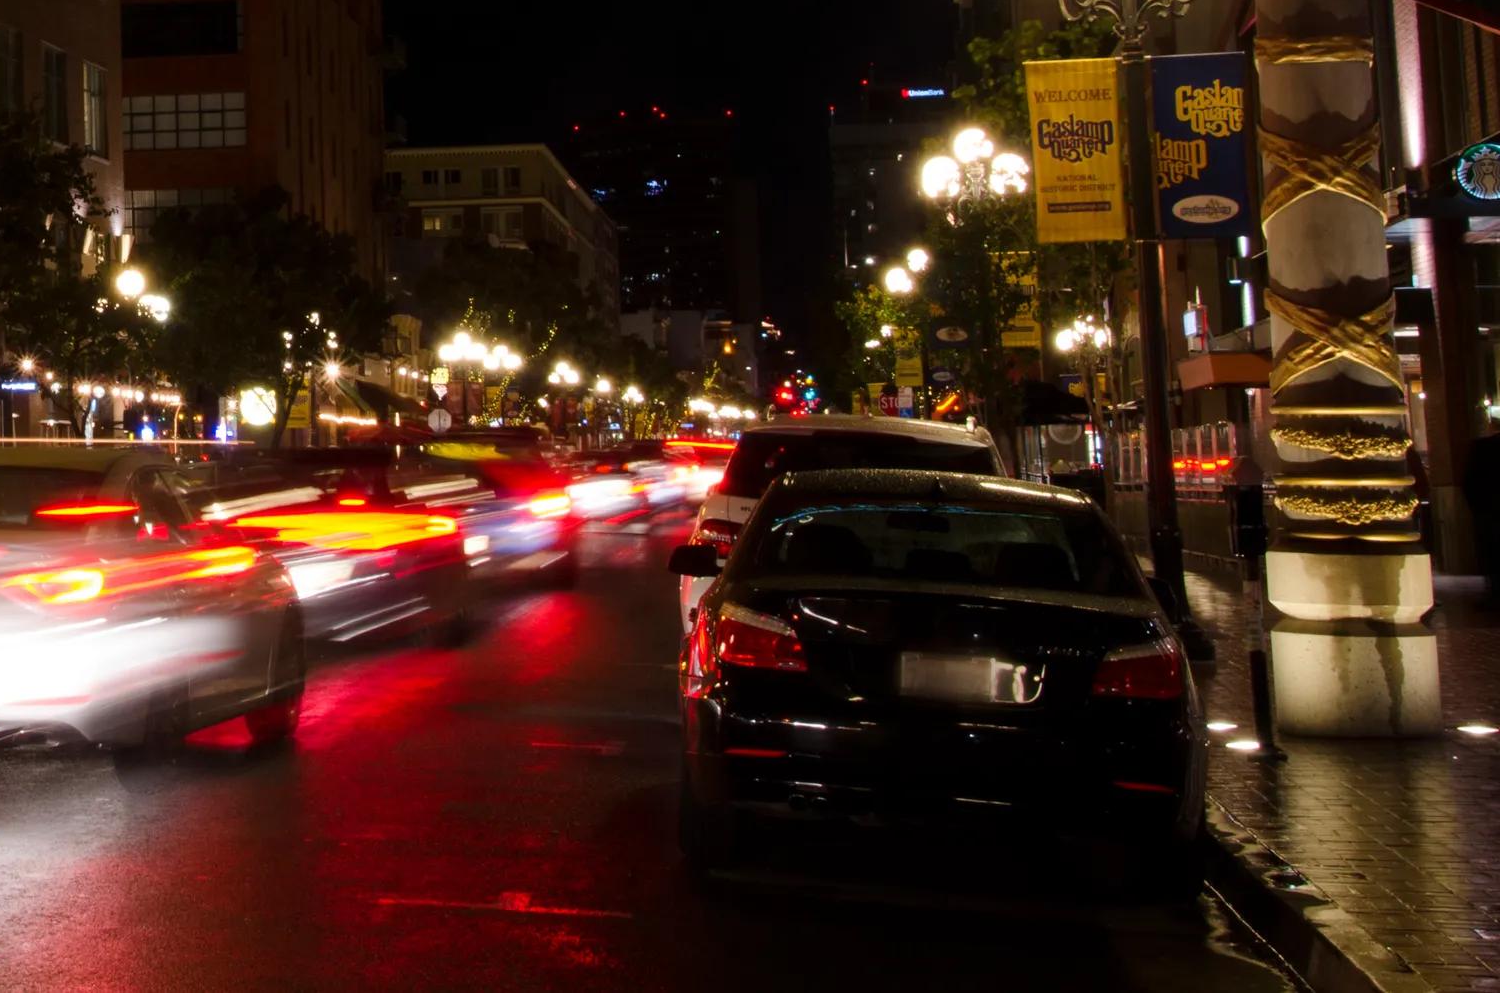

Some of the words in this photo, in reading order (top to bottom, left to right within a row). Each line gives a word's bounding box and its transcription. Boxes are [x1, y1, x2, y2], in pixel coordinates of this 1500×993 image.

[1034, 88, 1112, 103] WELCOME
[1037, 113, 1115, 149] Gaslamp
[1051, 137, 1108, 163] Quarter
[1055, 173, 1098, 181] NATIONAL
